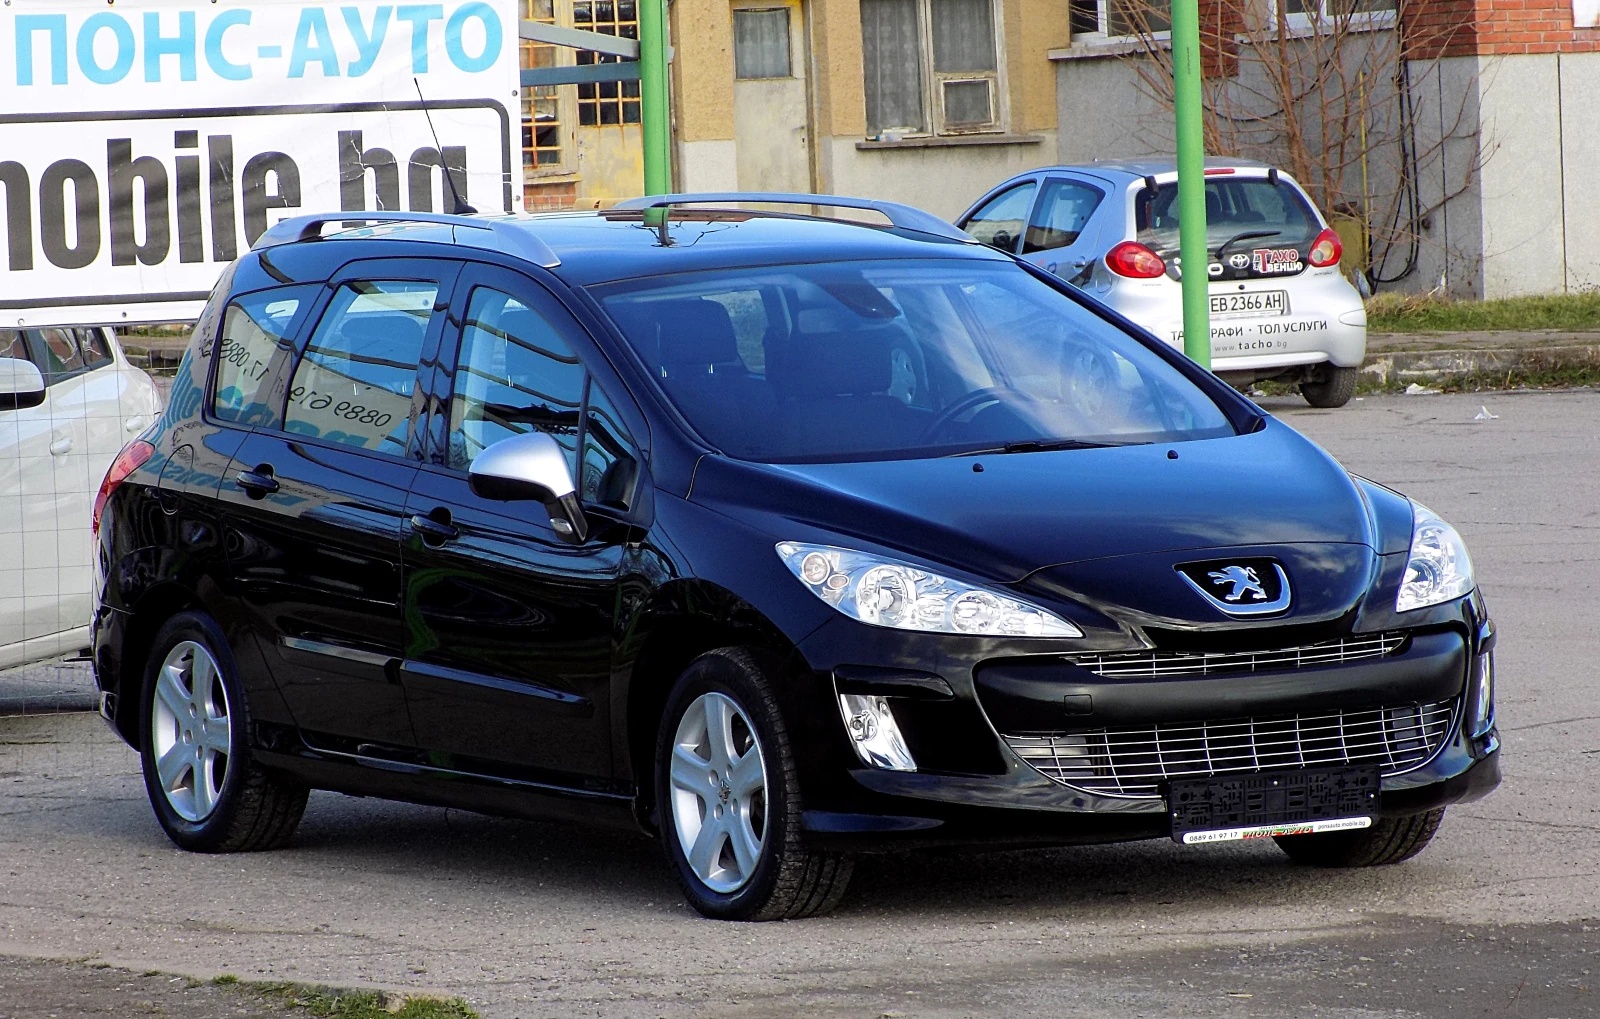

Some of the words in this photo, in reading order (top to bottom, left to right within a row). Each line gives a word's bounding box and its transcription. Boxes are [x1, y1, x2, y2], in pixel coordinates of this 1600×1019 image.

[15, 2, 503, 86] ПОНС-АУТО
[0, 130, 468, 270] obileb
[1230, 295, 1262, 311] 2366
[1257, 323, 1280, 335] ТОЛ
[1283, 320, 1328, 333] УСЛУГИ
[1189, 834, 1207, 842] 0889
